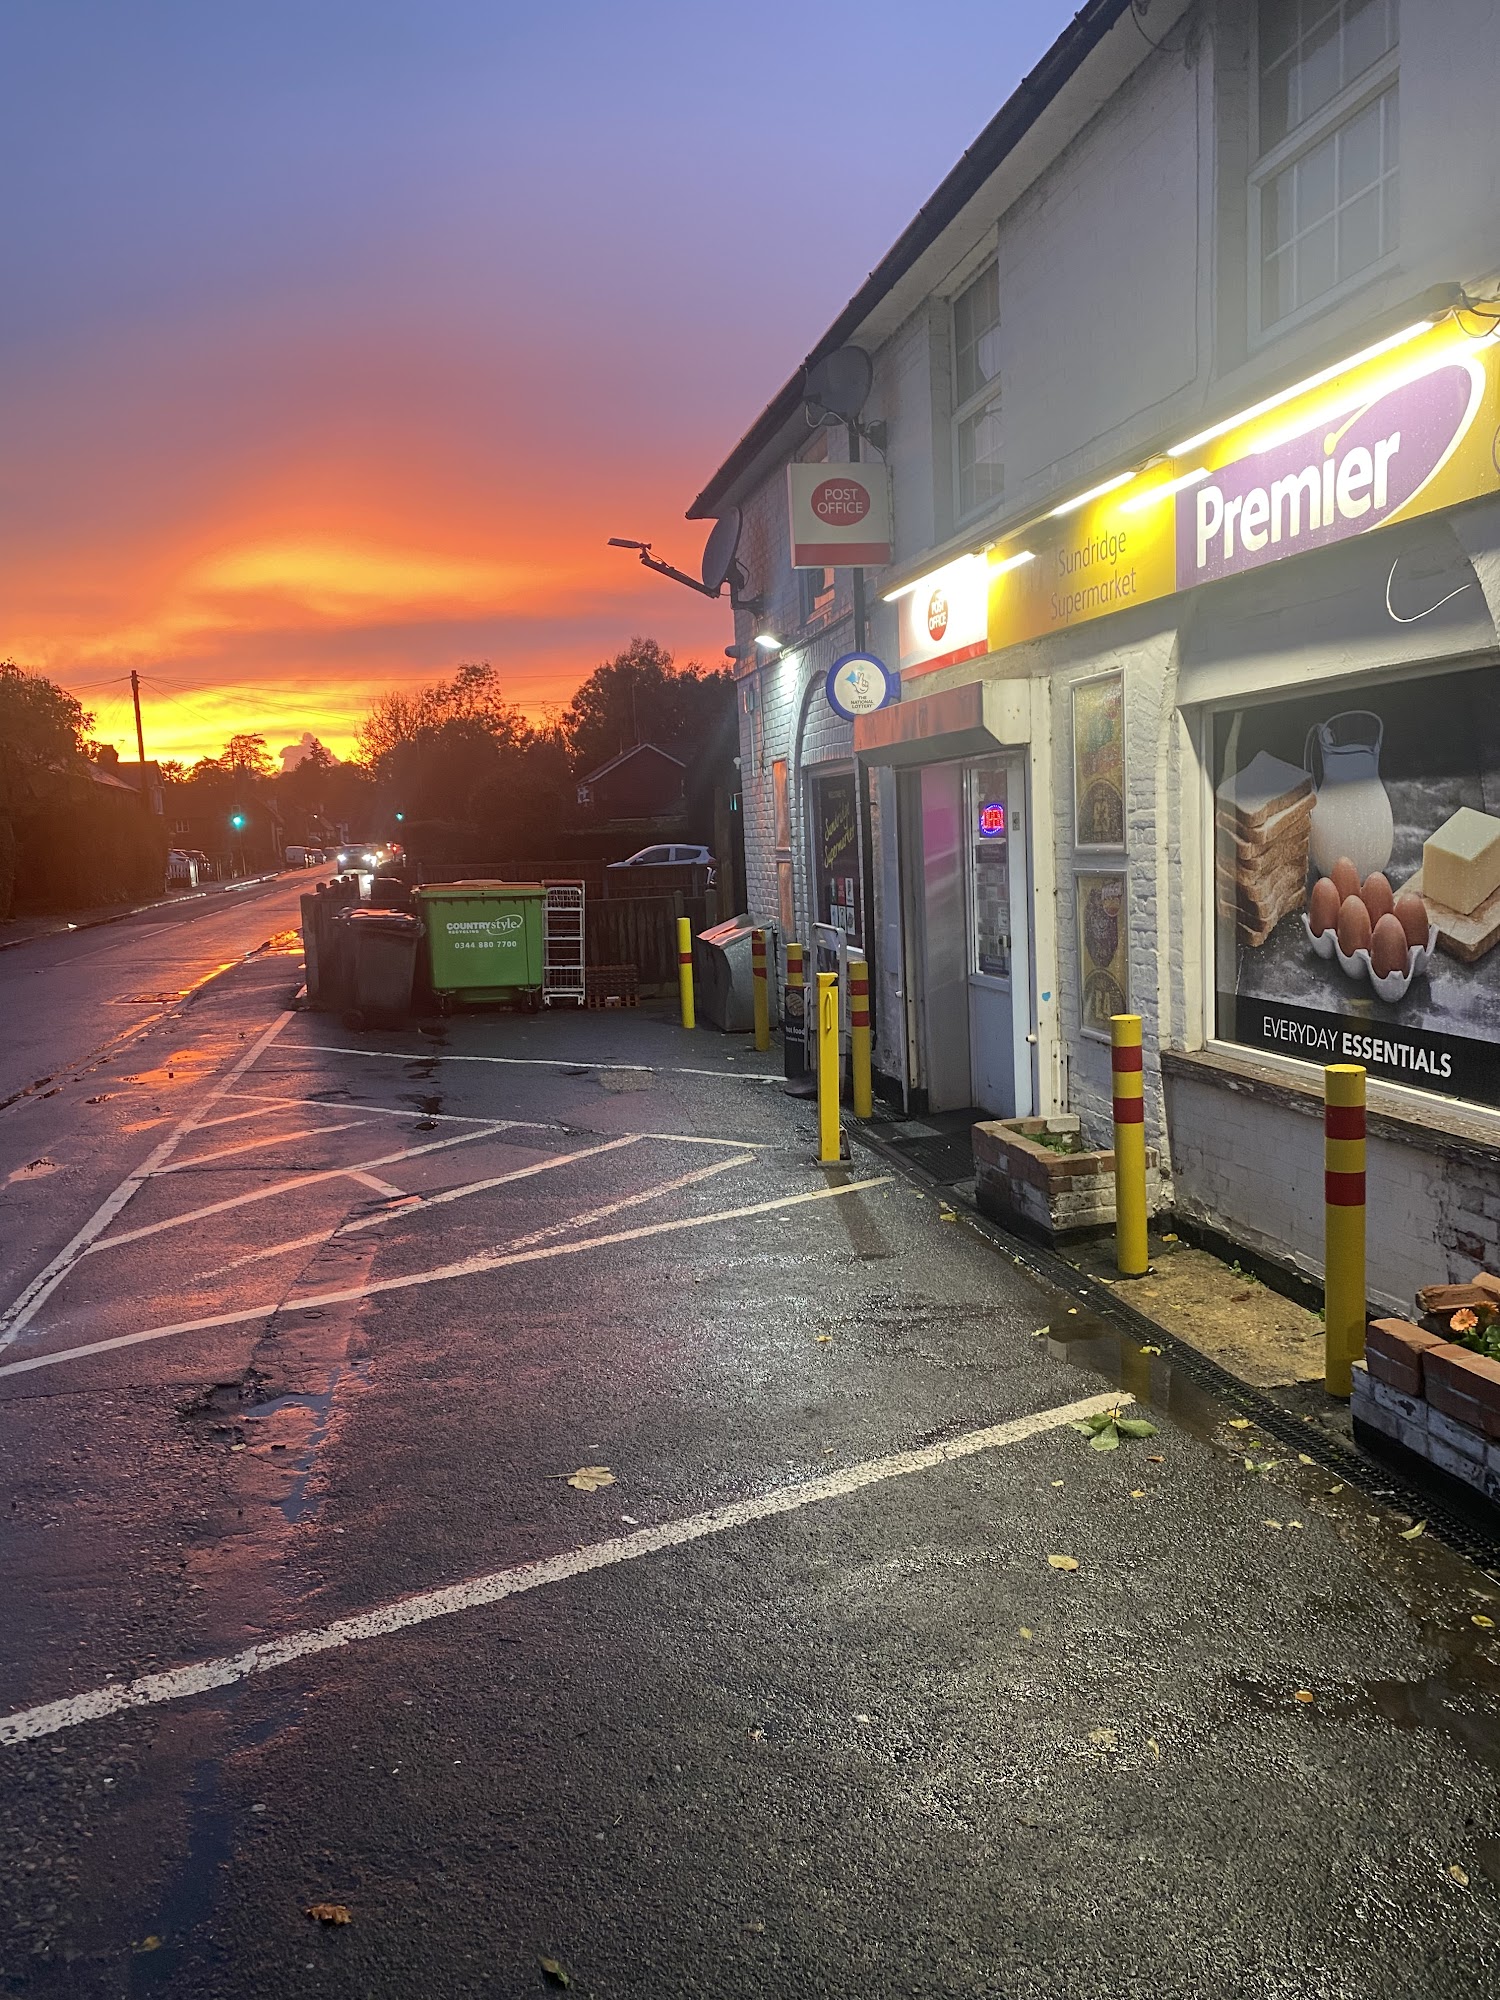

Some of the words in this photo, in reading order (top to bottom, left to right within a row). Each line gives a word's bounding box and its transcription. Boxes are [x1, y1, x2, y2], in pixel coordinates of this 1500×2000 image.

[817, 502, 863, 515] OFFICE
[825, 488, 858, 501] POST
[1196, 430, 1401, 569] Premier
[1058, 530, 1126, 577] Sundridge
[1051, 567, 1137, 623] Supermarket
[929, 611, 947, 630] OFFICE
[478, 941, 494, 949] 880
[497, 940, 517, 948] 7700
[1263, 1016, 1338, 1051] EVERYDAY
[1342, 1033, 1452, 1078] ESSENTIALS
